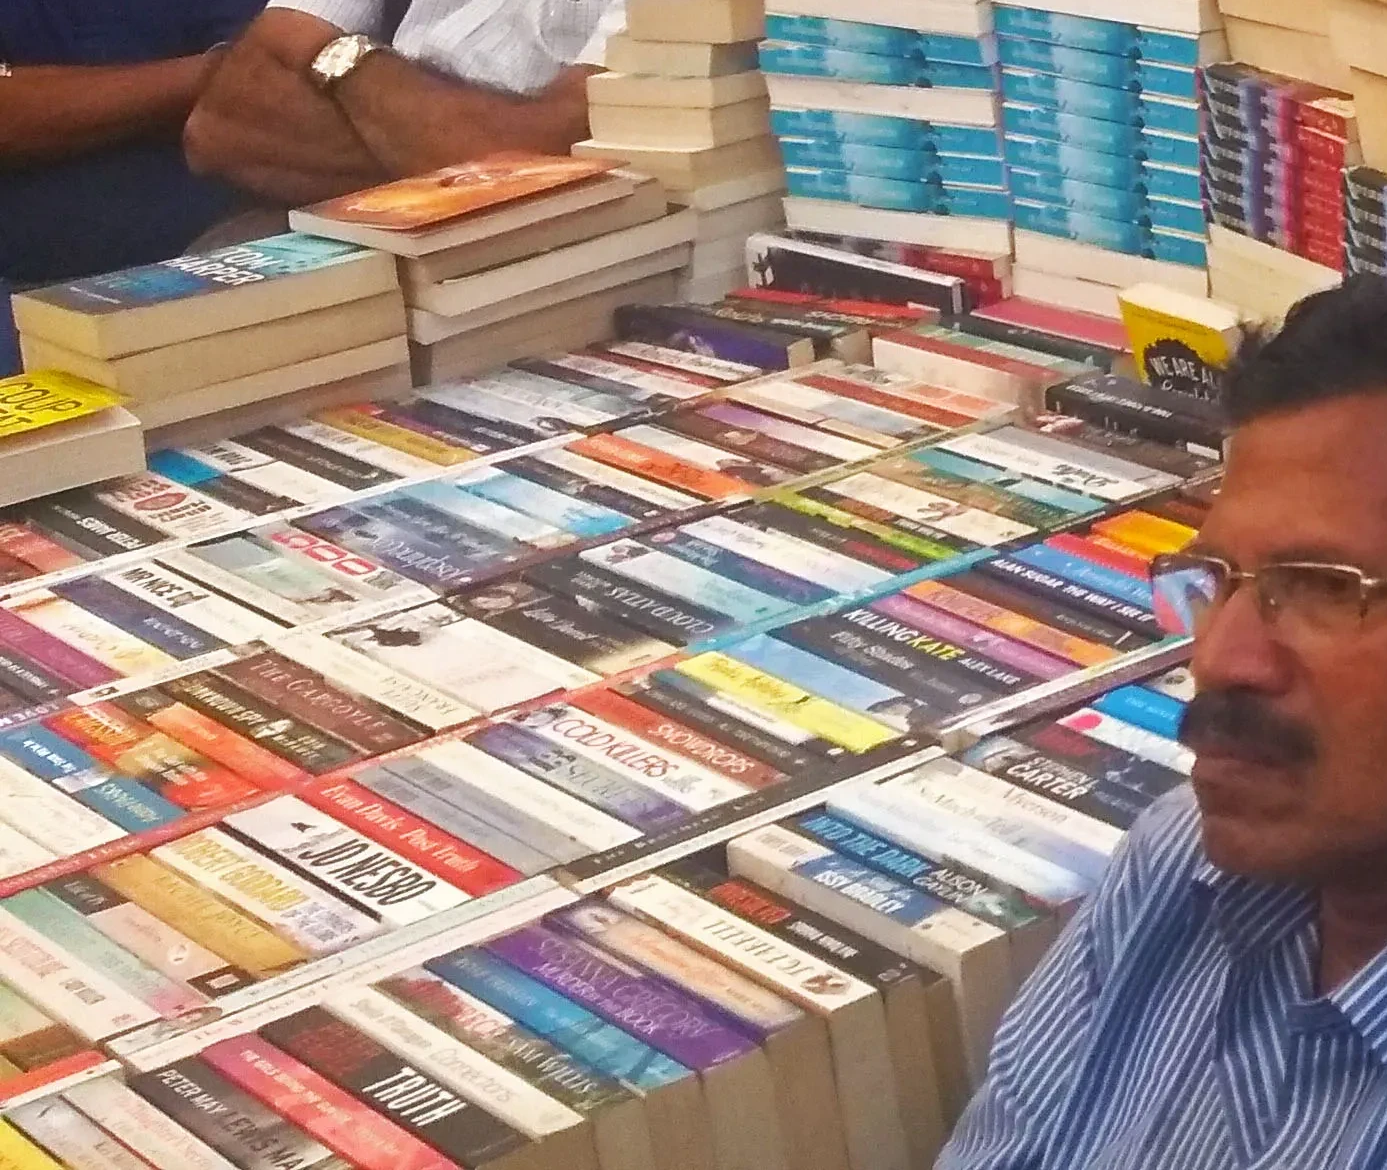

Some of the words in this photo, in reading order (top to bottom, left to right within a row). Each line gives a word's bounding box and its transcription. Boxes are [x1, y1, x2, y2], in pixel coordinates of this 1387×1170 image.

[158, 255, 265, 285] HARPER
[210, 246, 284, 270] TOM
[1150, 356, 1173, 377] WE
[1173, 357, 1199, 381] ARE
[76, 517, 114, 543] JAMES
[108, 529, 147, 550] PETER
[120, 567, 154, 587] MR
[145, 574, 183, 598] NICE
[605, 586, 656, 610] ATLAS
[990, 557, 1022, 576] ALAN
[1021, 564, 1064, 589] SUGAR
[1062, 584, 1088, 599] THE
[1084, 590, 1112, 608] WAY
[651, 605, 714, 634] CLOUD
[842, 607, 919, 643] KILLING
[908, 633, 966, 660] KATE
[958, 656, 993, 674] ALEX
[251, 658, 286, 684] THE
[287, 678, 387, 731] GARGOYLE
[552, 718, 614, 753] COLD
[603, 735, 680, 777] KILLERS
[648, 723, 755, 773] SNOWDROPS
[1006, 763, 1088, 800] CARTER
[320, 784, 360, 810] Evan
[354, 800, 404, 831] Davis
[399, 827, 438, 851] Post
[432, 843, 480, 874] Truth
[801, 815, 854, 841] INTO
[845, 832, 887, 855] THE
[872, 846, 933, 878] DARK
[297, 838, 371, 868] JO
[328, 852, 438, 906] NESBO
[813, 868, 846, 890] ISSY
[842, 880, 906, 915] BRADLEY
[929, 868, 990, 897] ALISON
[531, 962, 592, 998] MURDER
[615, 1007, 663, 1035] BOOK
[156, 1068, 203, 1103] PETER
[193, 1092, 228, 1116] MAY
[361, 1065, 468, 1128] TRUTH
